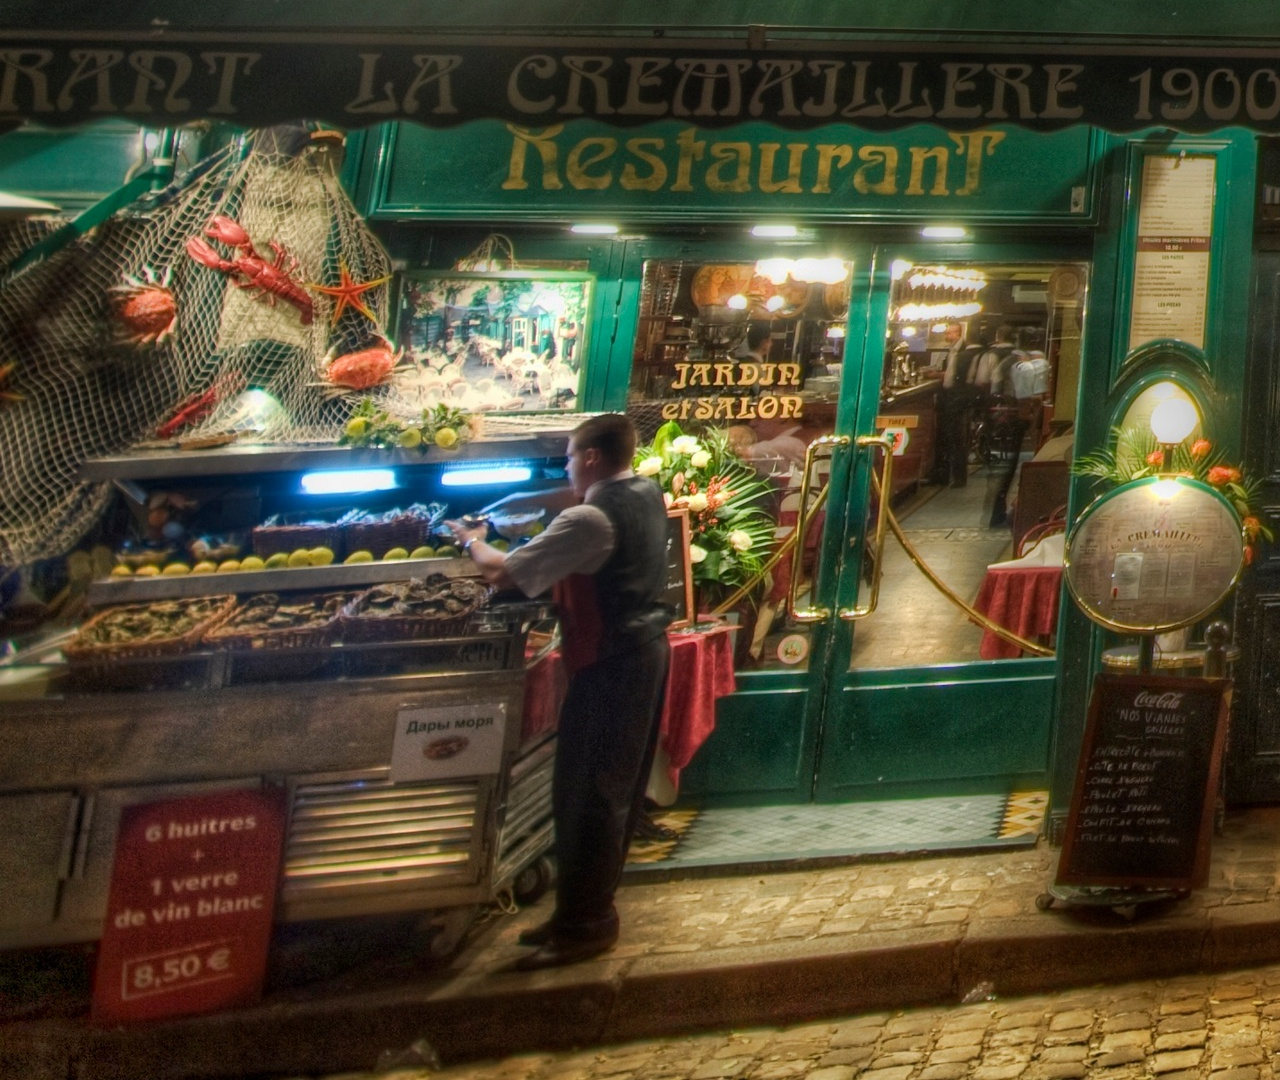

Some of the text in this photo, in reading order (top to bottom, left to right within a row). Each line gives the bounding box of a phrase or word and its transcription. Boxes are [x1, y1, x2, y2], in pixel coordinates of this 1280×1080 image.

[343, 52, 464, 115] LA
[506, 53, 1087, 120] CREMAILLERE
[671, 363, 801, 389] JARDIN
[661, 396, 803, 420] et SALON
[406, 717, 494, 734] Дары моря
[146, 825, 163, 842] 6
[192, 849, 205, 861] +
[151, 872, 239, 895] 1 verre
[115, 894, 263, 929] de vin blanc
[134, 947, 231, 989] 8,50 €
